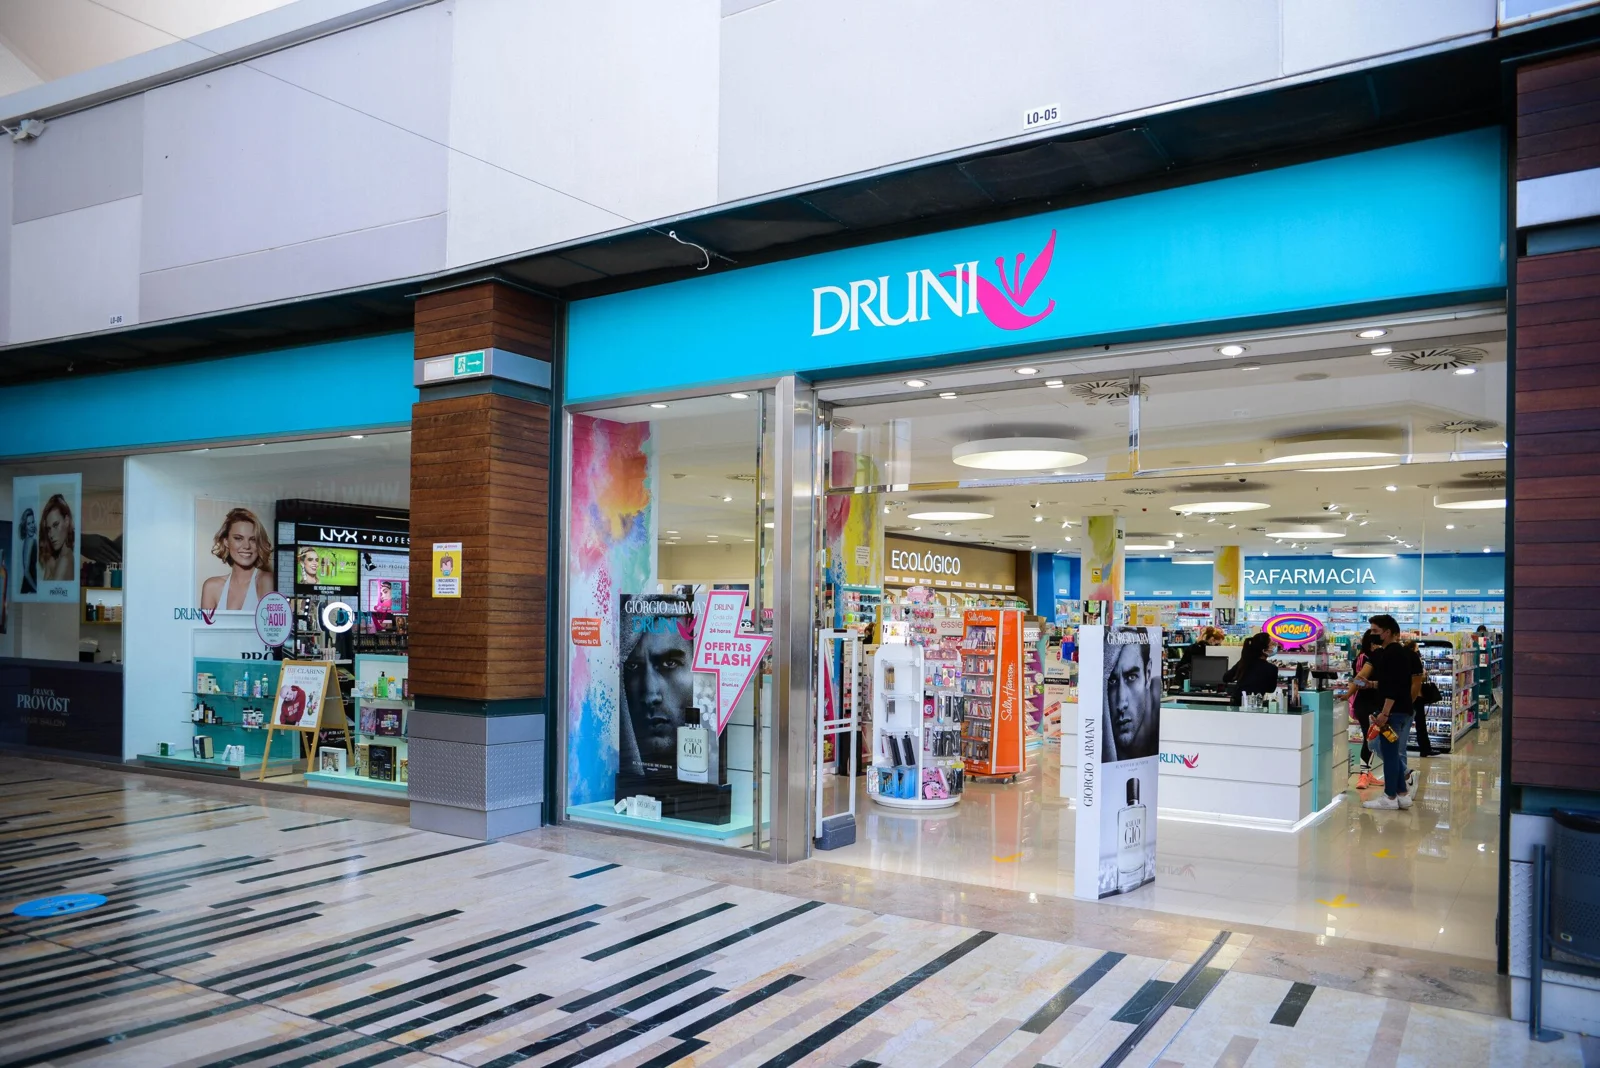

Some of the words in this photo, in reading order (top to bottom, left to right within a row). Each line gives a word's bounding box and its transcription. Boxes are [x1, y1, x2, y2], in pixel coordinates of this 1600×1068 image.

[811, 260, 980, 337] DRUNI
[320, 528, 358, 543] NYX
[891, 550, 961, 575] ECOLÓGICO
[1243, 568, 1377, 585] RAFARMACIA
[174, 607, 205, 620] DRUNI
[266, 603, 284, 611] RECOGE
[624, 601, 668, 614] GIORGIO
[714, 603, 734, 611] DRUNI
[632, 616, 678, 633] DRUNI
[941, 620, 963, 629] essie
[1107, 632, 1135, 645] GIORGIO
[704, 641, 752, 652] OFERTAS
[704, 653, 751, 667] FLASH
[297, 667, 325, 675] CLARINS
[1003, 662, 1016, 699] Hansen
[33, 688, 55, 697] FRANCK
[16, 693, 70, 713] PROVOST
[1001, 696, 1016, 721] Sally
[1084, 718, 1095, 760] ARMANI
[1083, 762, 1094, 807] GIORGIO
